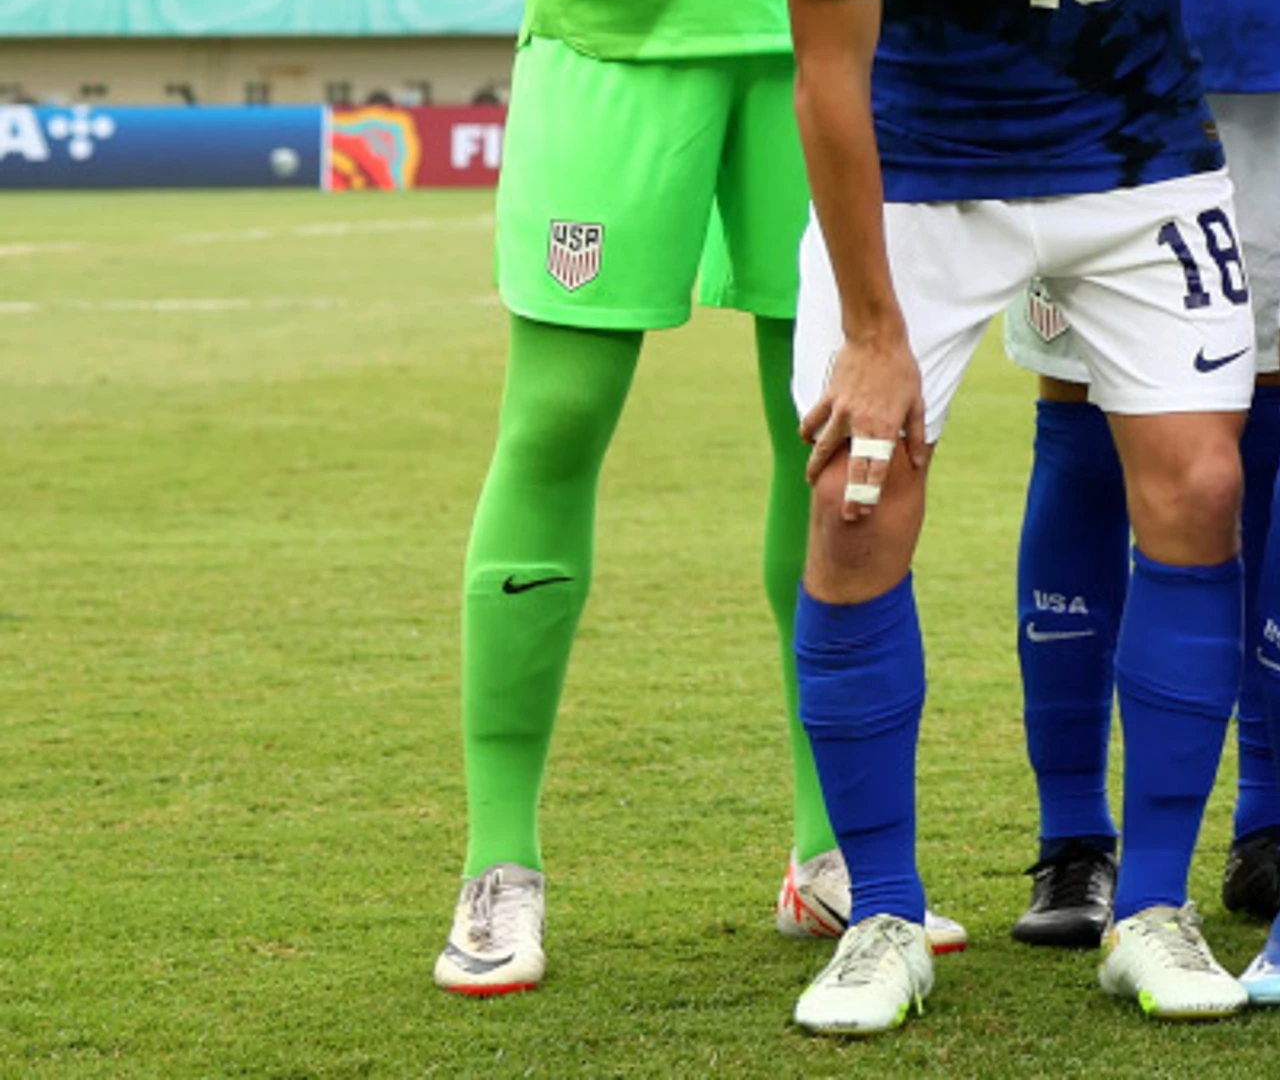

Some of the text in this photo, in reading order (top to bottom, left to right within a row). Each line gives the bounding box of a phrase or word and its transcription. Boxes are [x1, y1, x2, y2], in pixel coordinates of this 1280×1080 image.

[554, 224, 600, 252] USA
[1157, 207, 1248, 310] 18
[1034, 589, 1089, 615] USA
